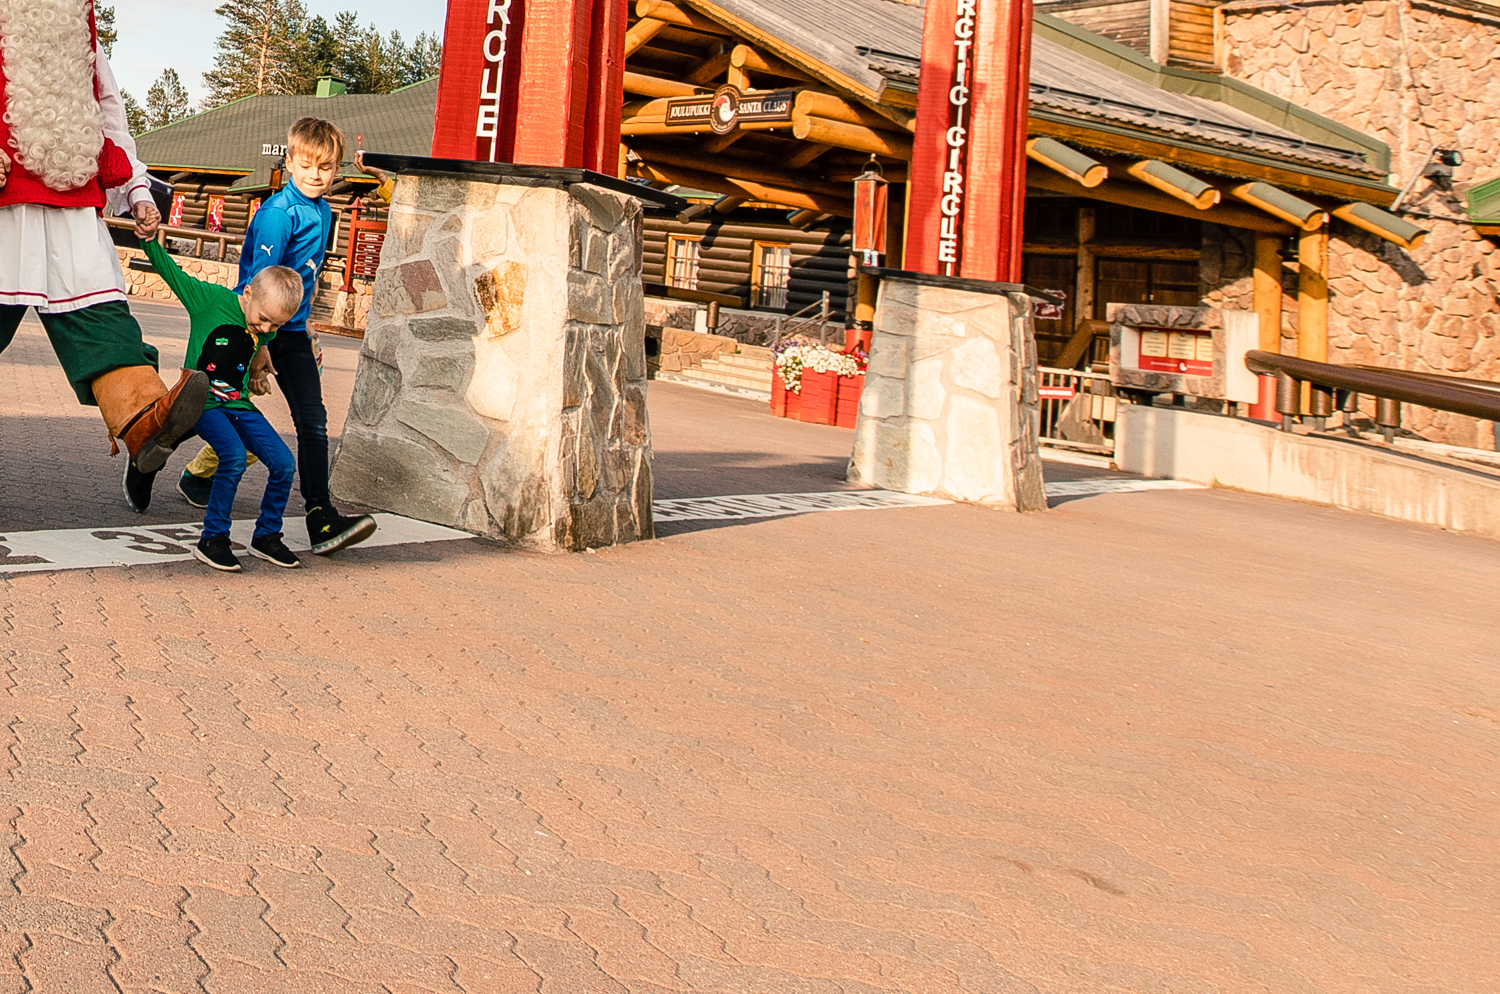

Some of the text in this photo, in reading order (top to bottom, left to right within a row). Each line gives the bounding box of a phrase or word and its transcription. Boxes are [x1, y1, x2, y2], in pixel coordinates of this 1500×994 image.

[670, 100, 787, 118] JOULUPUKKI SANTA CLAUS
[262, 143, 288, 155] mar
[938, 126, 967, 263] CIRCLE
